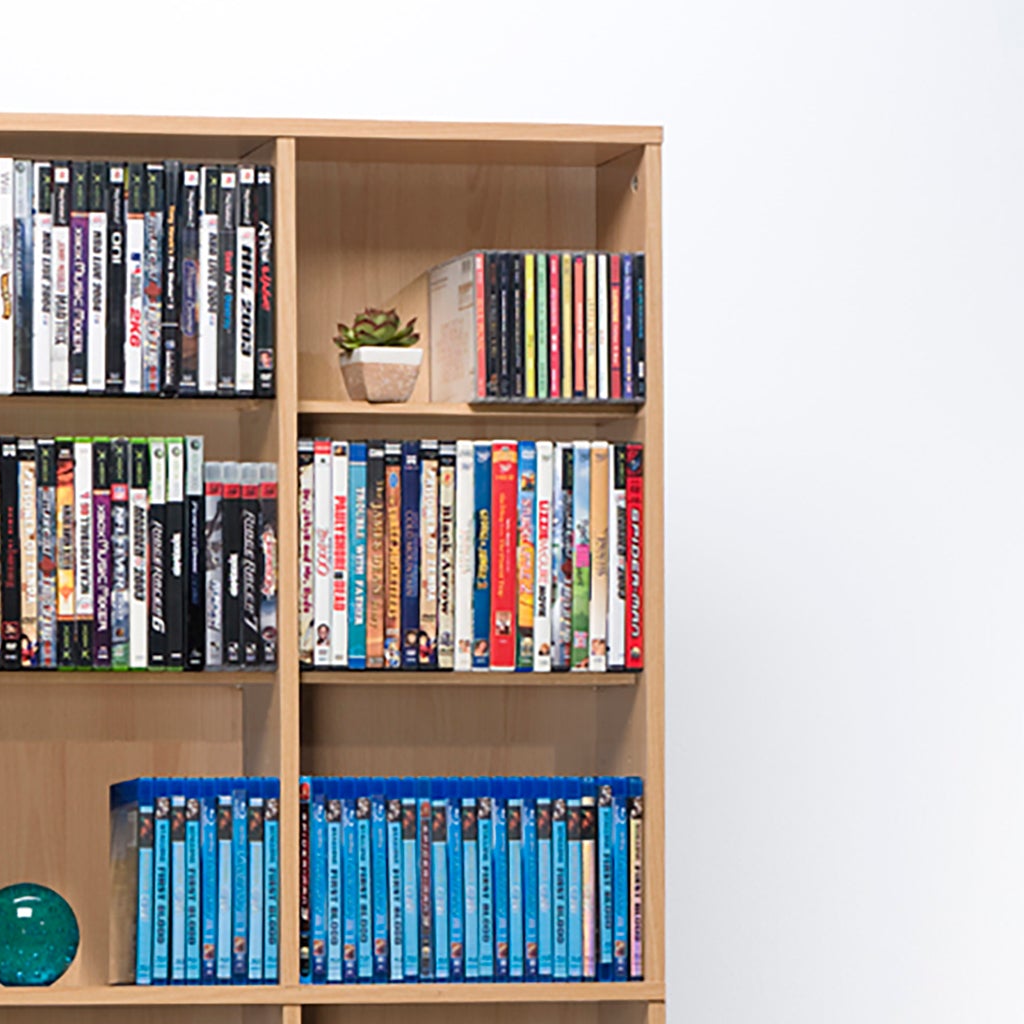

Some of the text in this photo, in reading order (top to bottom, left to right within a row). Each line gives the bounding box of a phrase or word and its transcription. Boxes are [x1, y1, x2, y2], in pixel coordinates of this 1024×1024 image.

[241, 245, 252, 293] NHL
[130, 307, 141, 347] 2K6
[442, 505, 453, 615] Black Arrow
[631, 508, 640, 637] SPIDER-MAN
